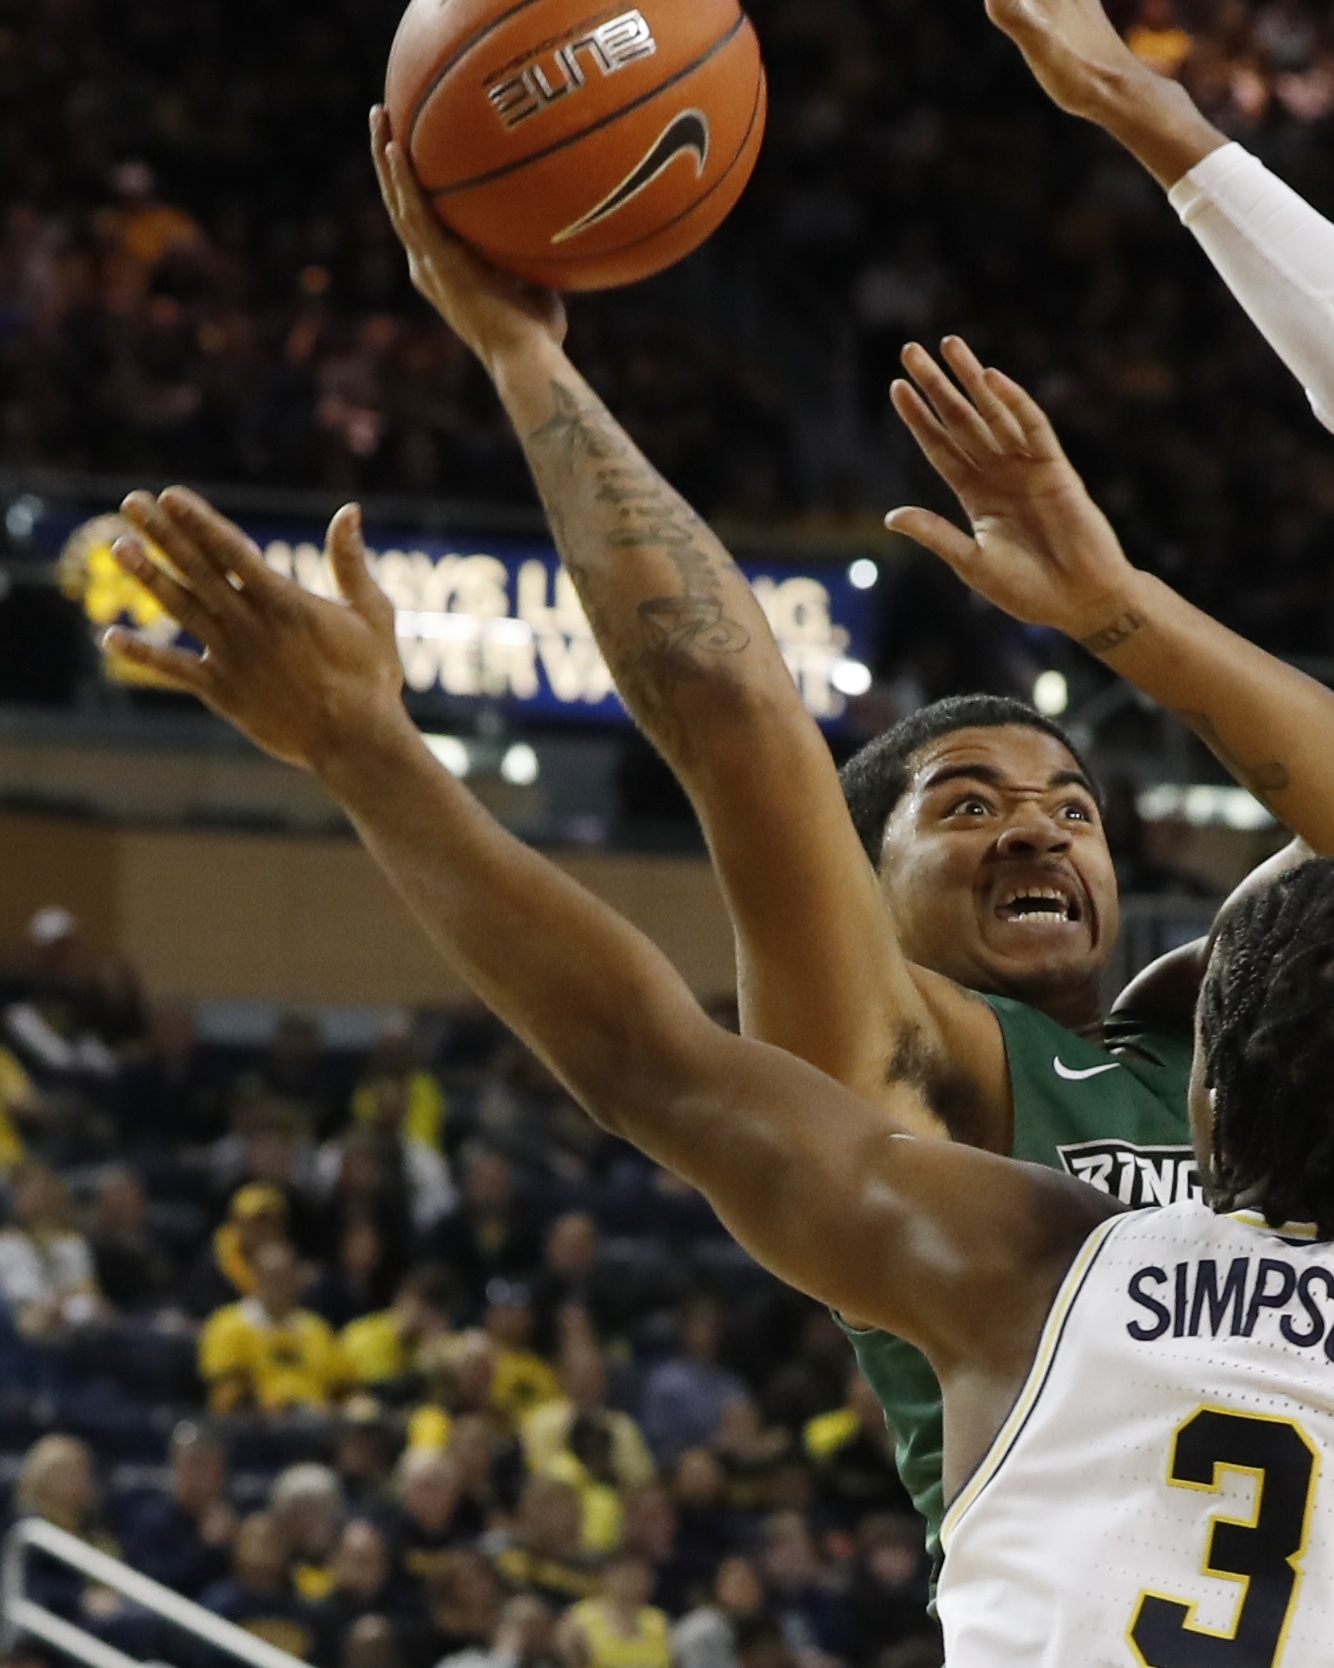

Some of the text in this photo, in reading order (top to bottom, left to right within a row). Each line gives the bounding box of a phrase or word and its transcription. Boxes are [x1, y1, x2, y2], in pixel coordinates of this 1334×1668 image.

[488, 8, 657, 132] ELITE
[1071, 1151, 1204, 1207] BING
[1124, 1403, 1322, 1668] 3
